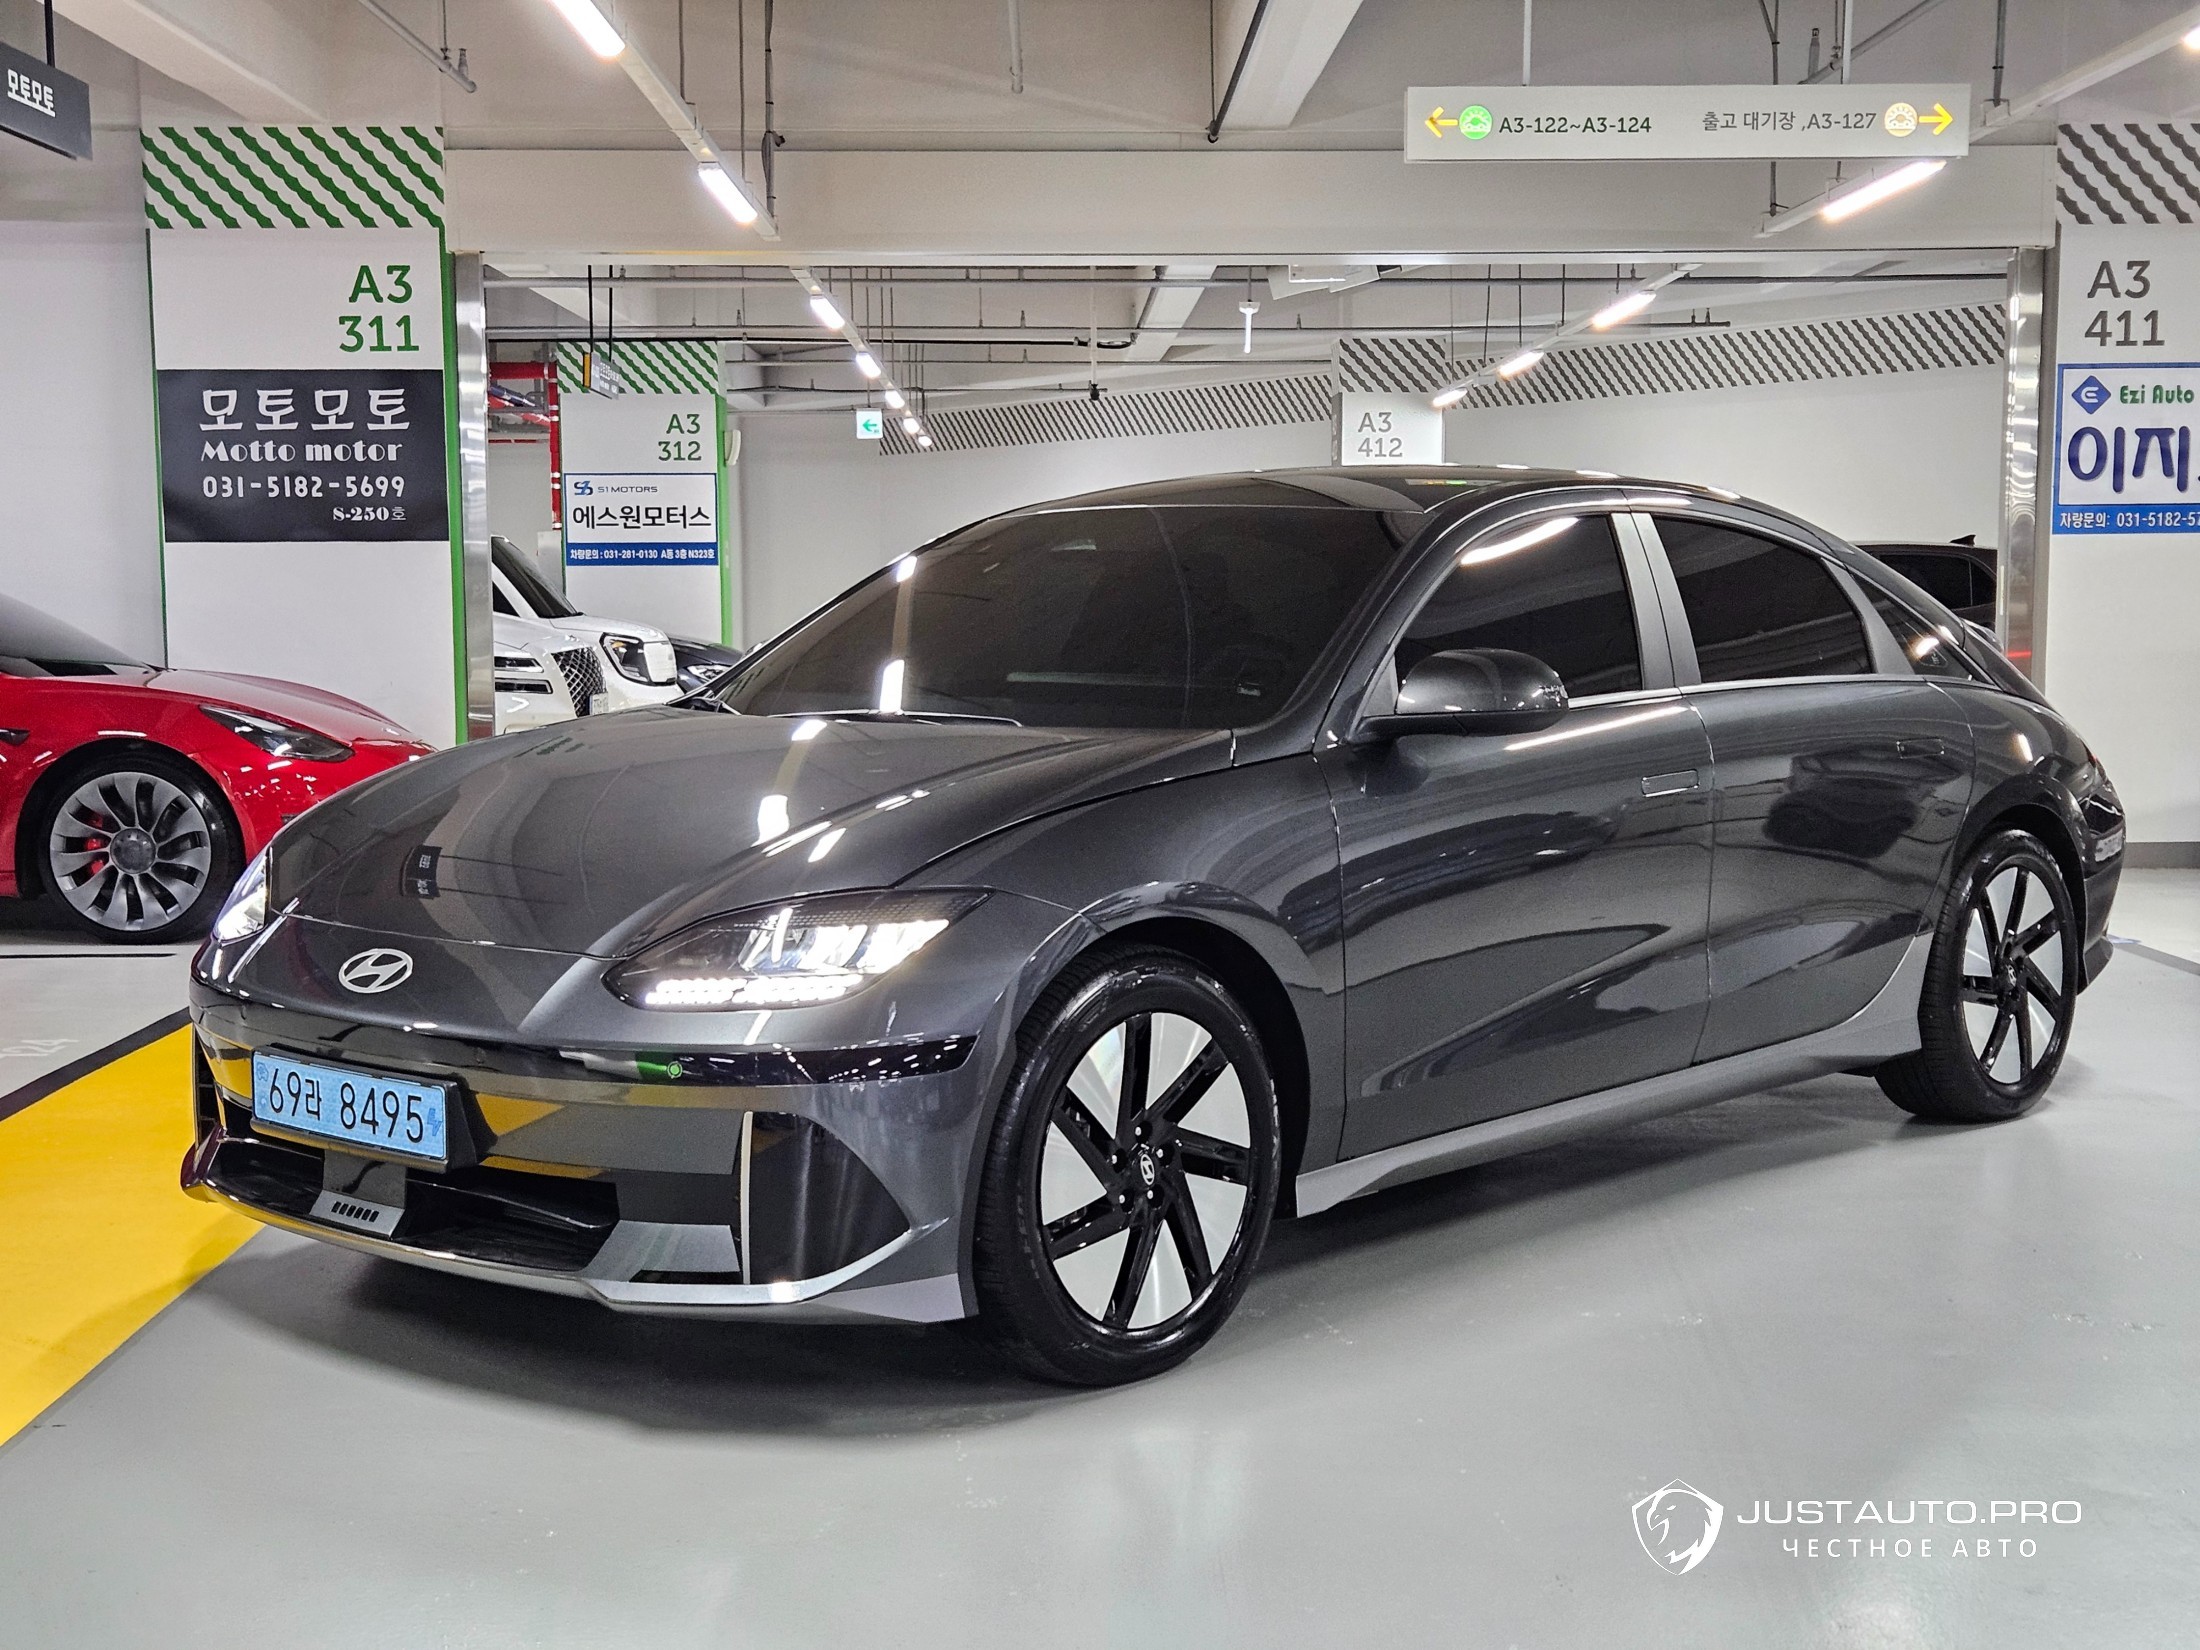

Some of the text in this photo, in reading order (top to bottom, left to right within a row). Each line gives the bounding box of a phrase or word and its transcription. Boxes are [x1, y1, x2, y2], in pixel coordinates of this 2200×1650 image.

[8, 68, 56, 118] 모토모토
[1499, 116, 1652, 133] A3-122~A3-124
[1702, 111, 1738, 131] 출고
[1743, 111, 1797, 131] 대기장
[348, 264, 413, 303] A3
[2087, 260, 2151, 299] A3
[338, 315, 420, 352] 311
[2084, 310, 2165, 347] 411
[2120, 384, 2195, 404] Ezi Auto
[199, 388, 410, 431] 모토모토
[666, 413, 701, 434] A3
[1357, 411, 1393, 433] A3
[201, 440, 403, 462] Motto motor
[658, 441, 702, 461] 312
[1357, 437, 1403, 458] 412
[202, 475, 406, 498] 031-5182-5699
[611, 486, 659, 494] MOTORS
[572, 504, 713, 530] 에스원모터스
[269, 1067, 424, 1144] 69라 8495
